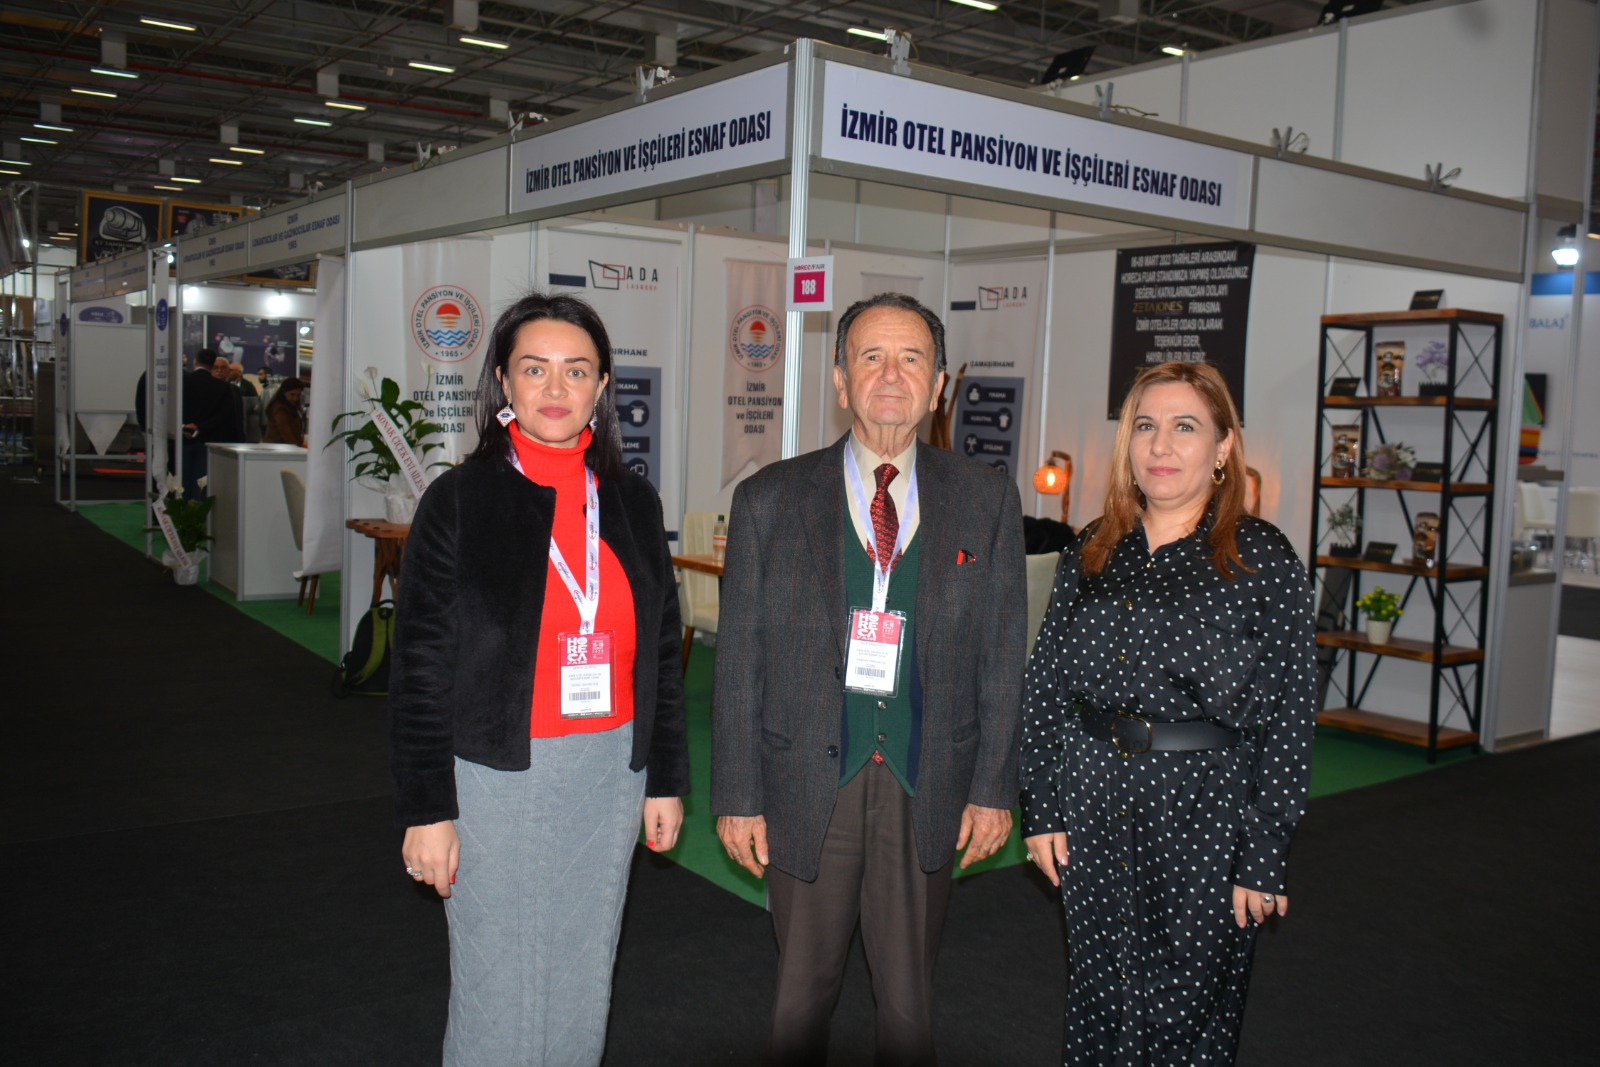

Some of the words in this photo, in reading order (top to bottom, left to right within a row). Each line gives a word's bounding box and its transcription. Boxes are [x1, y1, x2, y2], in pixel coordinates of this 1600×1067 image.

[526, 163, 550, 193] İZMİR
[551, 162, 571, 188] OTEL
[574, 149, 621, 182] PANSİYON
[623, 145, 636, 171] VE
[638, 127, 686, 172] İŞÇİLERİ
[687, 121, 726, 156] ESNAF
[729, 110, 771, 147] ODASI
[840, 103, 898, 147] İZMİR
[902, 120, 946, 155] OTEL
[950, 129, 1038, 172] PANSİYON
[1041, 148, 1061, 176] VE
[1064, 147, 1129, 189] İŞÇİLERİ
[1132, 166, 1177, 198] ESNAF
[1180, 175, 1222, 207] ODASI
[626, 266, 659, 283] ADA
[801, 279, 816, 295] 188
[1003, 286, 1027, 299] ADA
[415, 307, 424, 327] OTEL
[421, 290, 453, 310] PANSİYON
[455, 291, 464, 300] VE
[436, 373, 463, 385] İZMİR
[746, 381, 765, 392] İZMİR
[413, 390, 436, 401] OTEL
[438, 389, 478, 401] PANSİYO
[728, 396, 746, 406] OTEL
[747, 394, 782, 406] PANSİYON
[437, 406, 473, 420] İŞÇİLERİ
[376, 412, 394, 437] KONAK
[744, 425, 765, 434] ODASI
